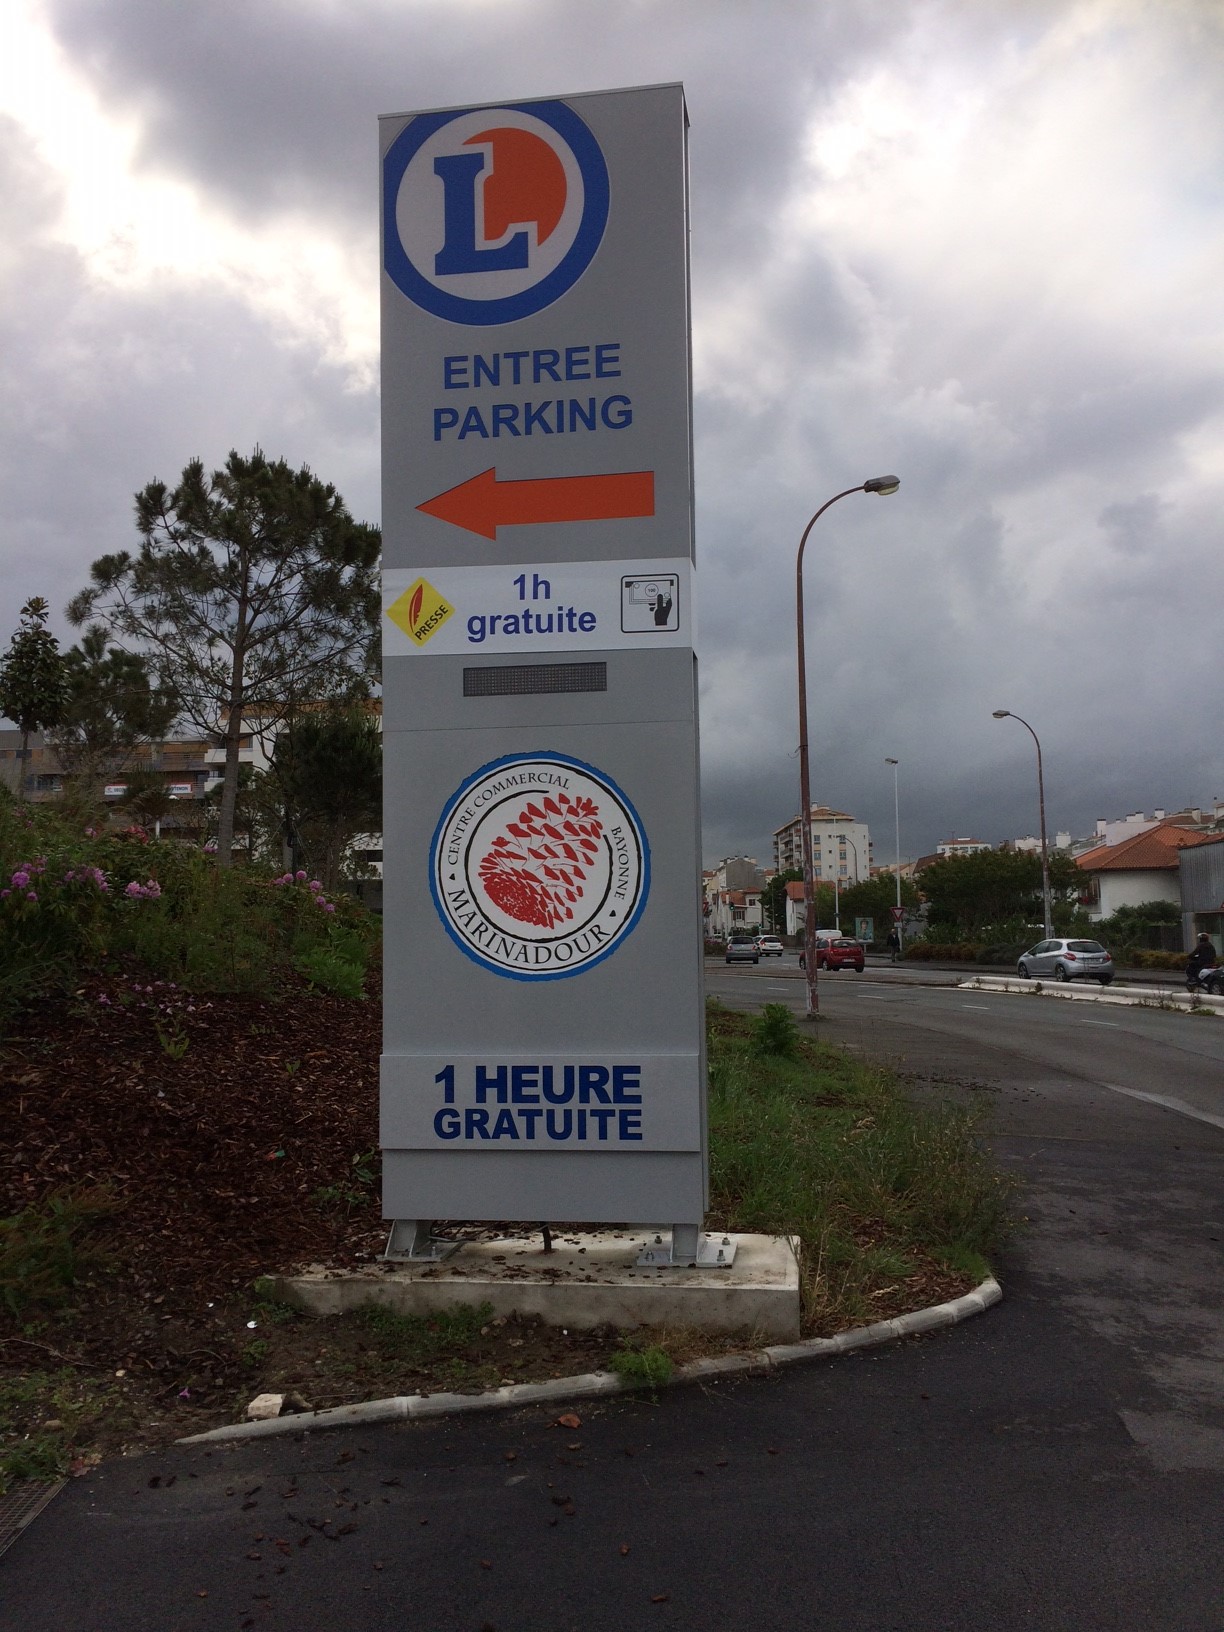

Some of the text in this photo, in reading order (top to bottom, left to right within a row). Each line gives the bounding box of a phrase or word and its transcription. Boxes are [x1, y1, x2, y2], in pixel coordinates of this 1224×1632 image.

[443, 343, 621, 390] ENTREE
[433, 395, 633, 441] PARKING
[513, 574, 551, 600] 1h
[414, 604, 449, 640] PRESSE
[467, 606, 597, 643] gratuite
[448, 772, 570, 865] CENTRE COMMERCIAL
[611, 826, 629, 899] BAYONNE
[448, 888, 610, 964] MARINADOUR
[435, 1065, 642, 1104] 1 HEURE
[433, 1107, 643, 1141] GRATUITE
